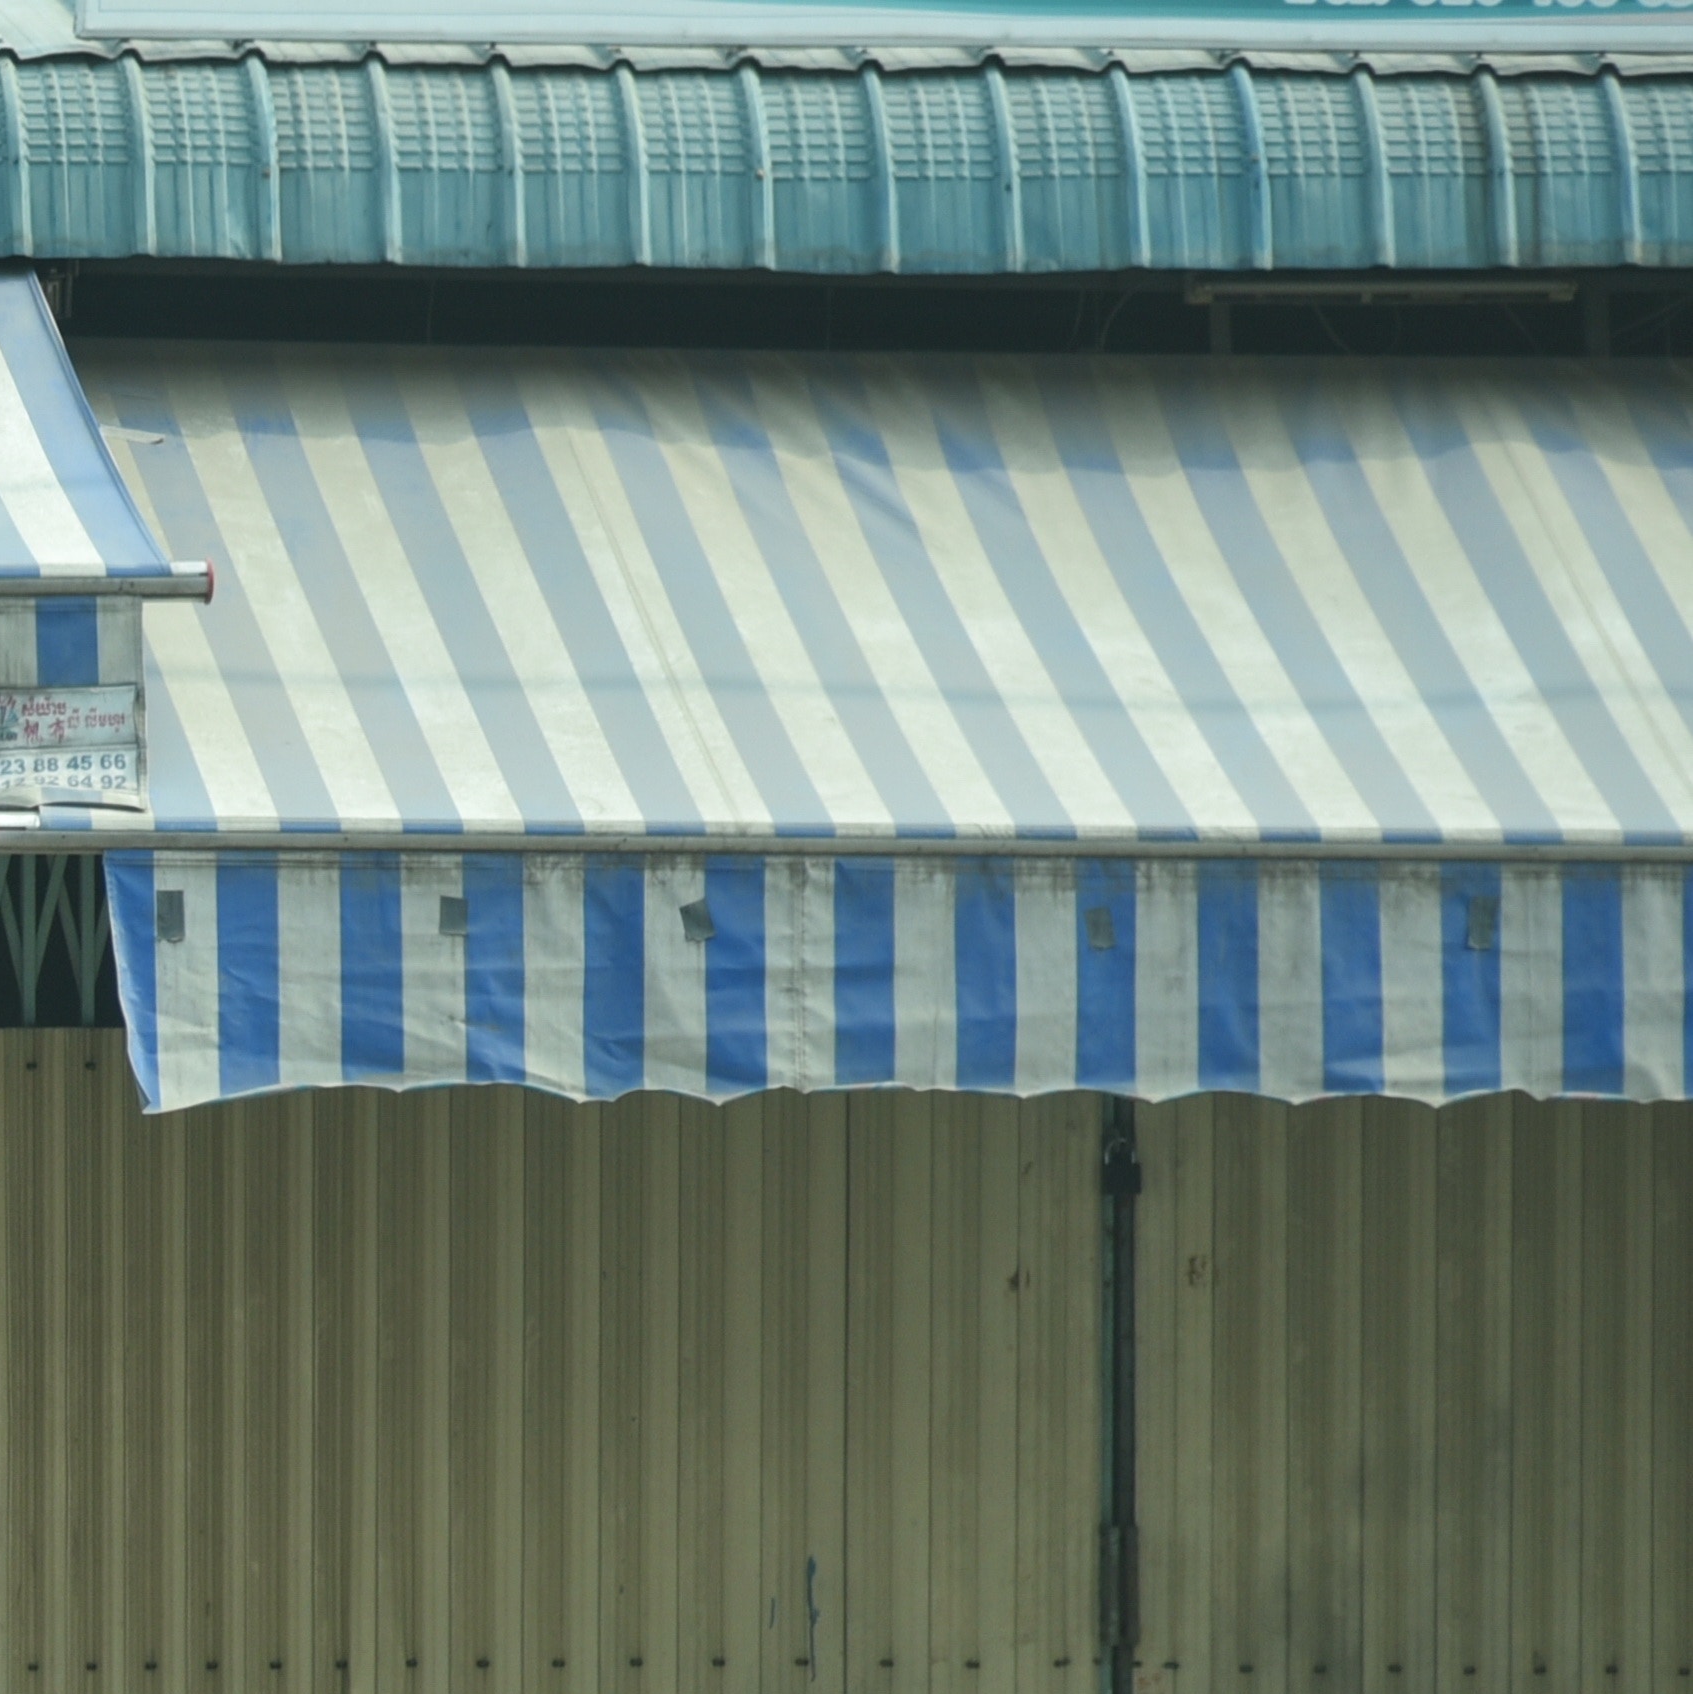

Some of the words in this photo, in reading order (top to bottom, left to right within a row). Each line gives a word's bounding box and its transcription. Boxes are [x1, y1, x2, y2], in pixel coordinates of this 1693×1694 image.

[32, 757, 59, 773] 88
[67, 755, 92, 771] 45
[100, 754, 126, 770] 66
[67, 774, 93, 788] 64
[100, 775, 126, 789] 92
